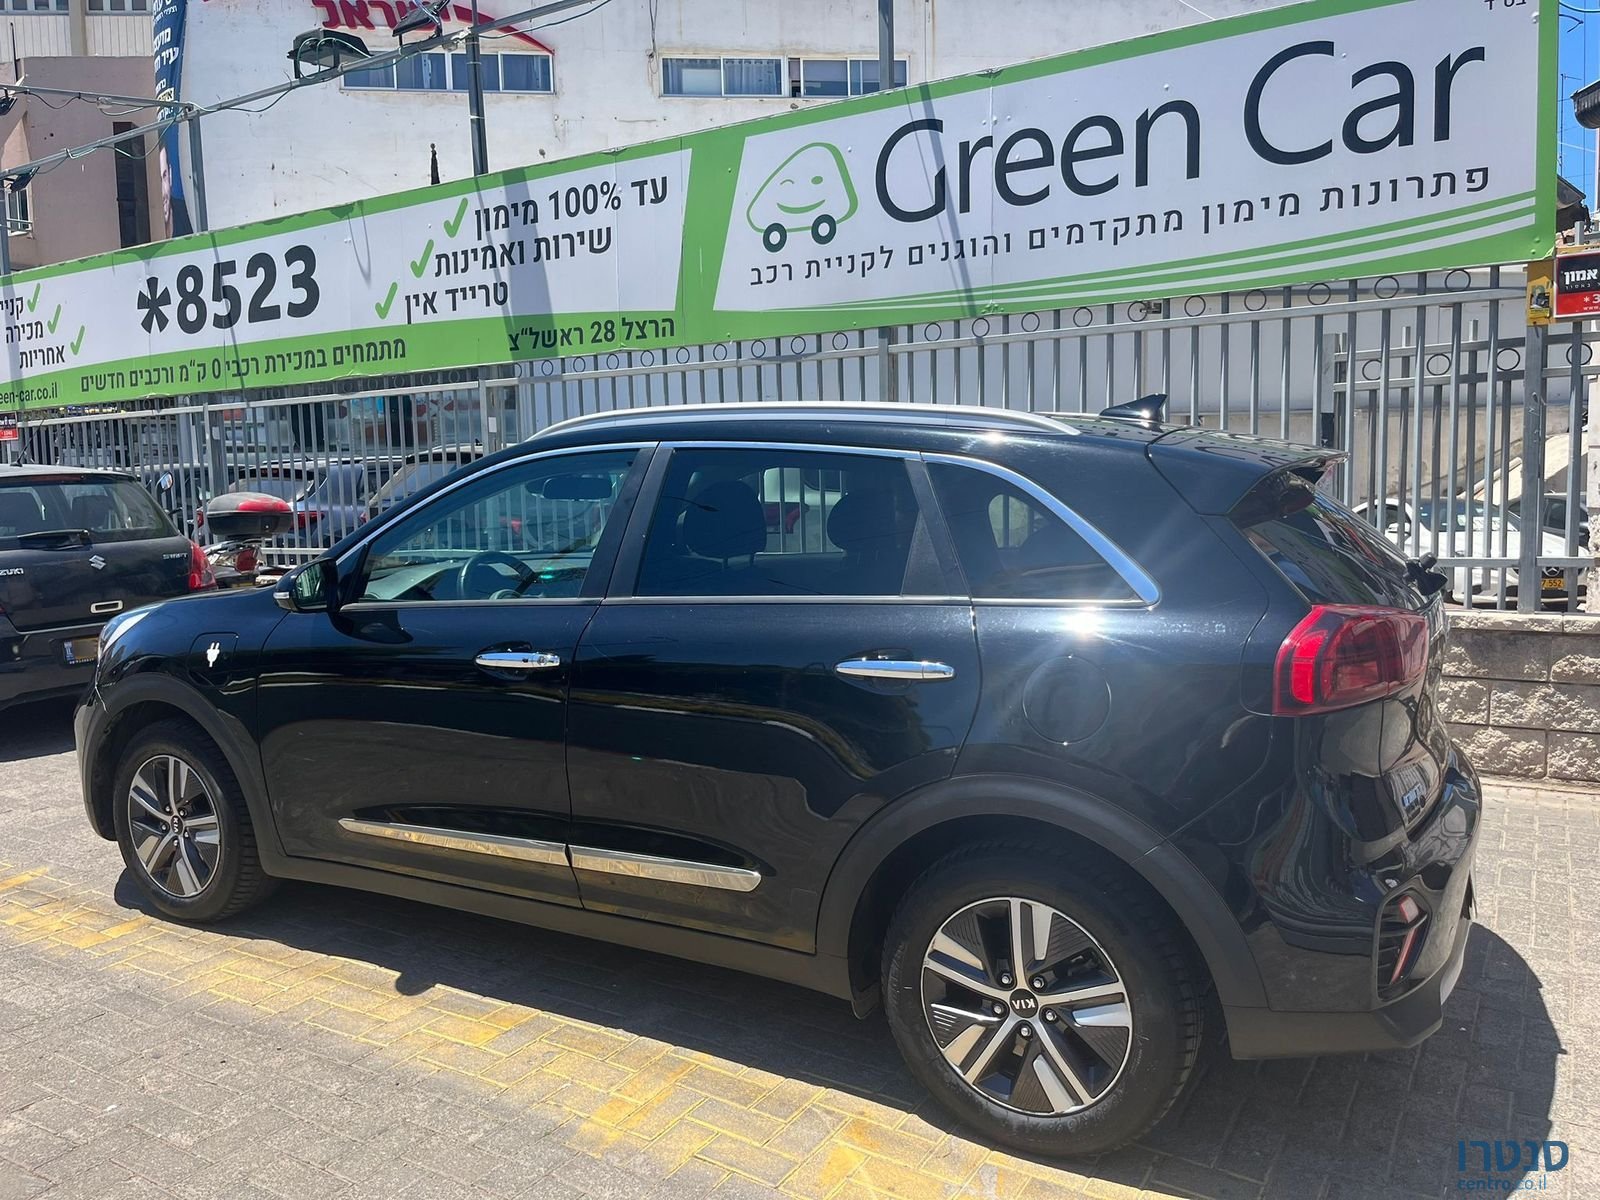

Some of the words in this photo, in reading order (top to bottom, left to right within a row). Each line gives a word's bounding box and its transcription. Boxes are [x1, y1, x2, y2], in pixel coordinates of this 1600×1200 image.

[875, 100, 1200, 223] Green
[1243, 40, 1486, 165] Car
[548, 181, 622, 220] 100%
[630, 176, 668, 206] עד
[1319, 167, 1489, 211] פתרונות
[474, 199, 539, 241] מימון
[1201, 193, 1300, 234] מימון
[1028, 209, 1183, 250] מתקדמים
[533, 226, 612, 263] שירות
[908, 233, 1011, 266] והוגנים
[435, 241, 525, 277] ואמינות
[804, 245, 894, 279] לקניית
[749, 263, 793, 286] רכב
[404, 290, 438, 325] אין
[445, 281, 508, 311] טרייד
[6, 320, 44, 344] מכירה
[509, 325, 583, 352] ראשל"צ
[590, 320, 616, 344] 28
[622, 316, 675, 341] הרצל
[19, 345, 65, 369] אחריות
[265, 349, 328, 374] במכירת
[333, 338, 406, 366] מתמחים
[81, 371, 125, 392] חדשים
[129, 366, 174, 387] ורכבים
[179, 359, 207, 383] ק"מ
[211, 358, 222, 380] 0
[225, 356, 259, 379] רכבי
[1011, 998, 1036, 1010] KIA
